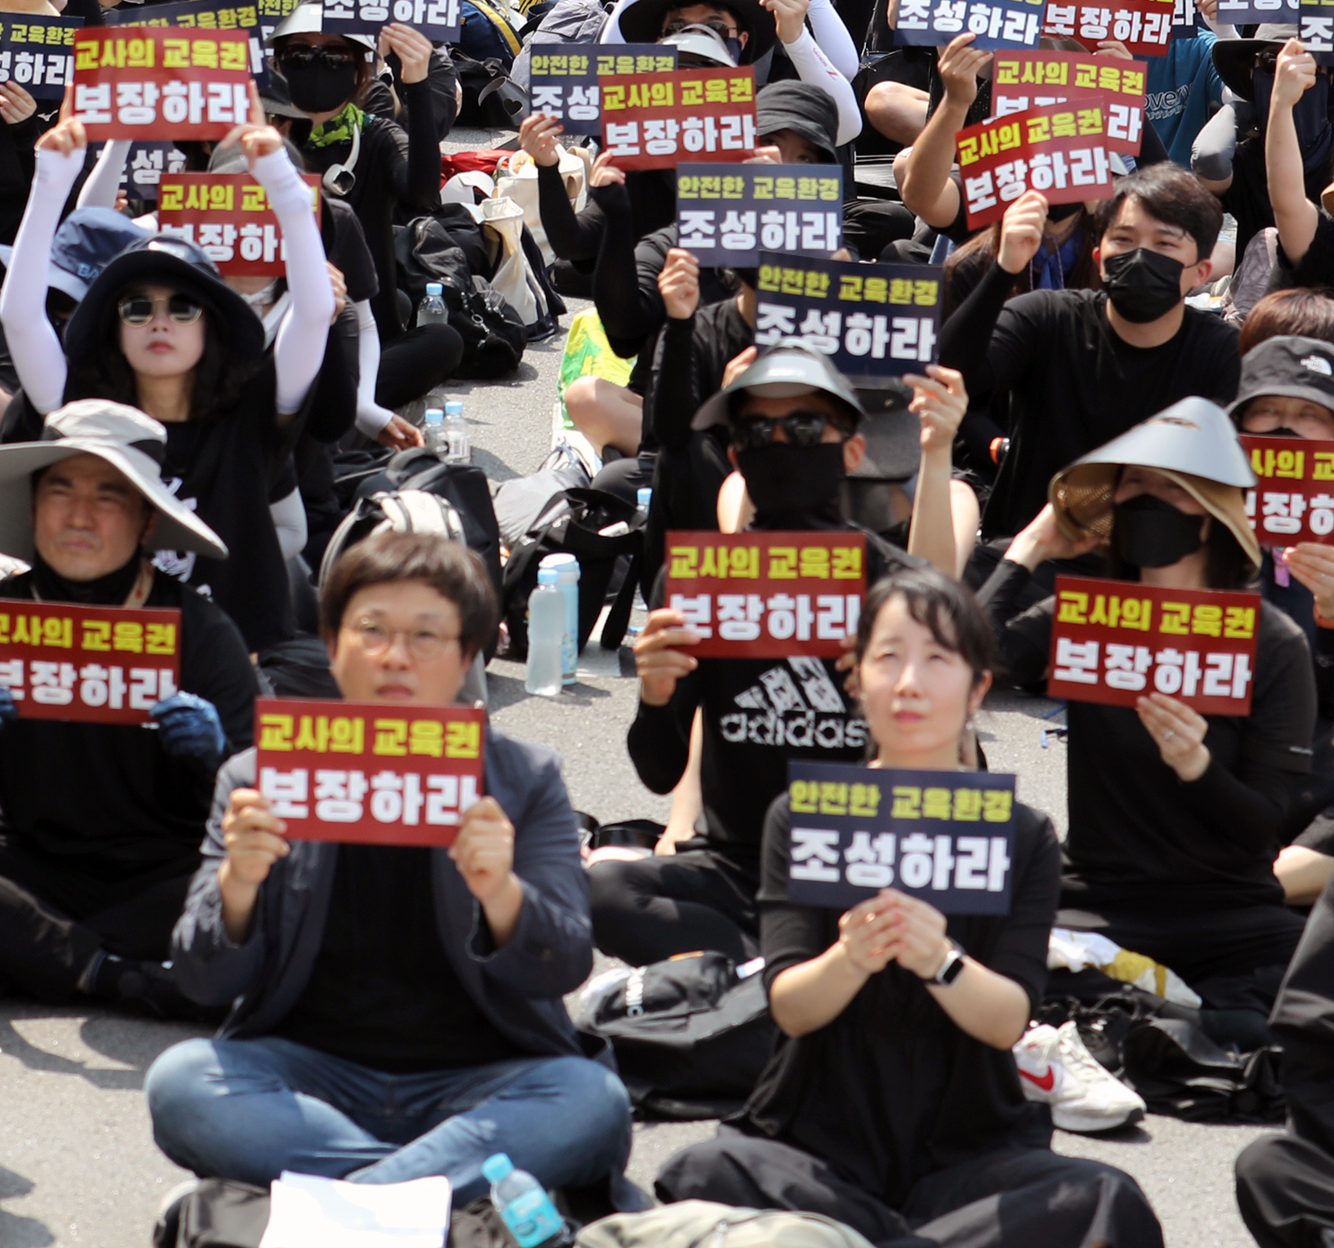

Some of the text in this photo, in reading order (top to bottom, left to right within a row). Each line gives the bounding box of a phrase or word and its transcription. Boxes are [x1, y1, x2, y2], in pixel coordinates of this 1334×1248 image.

[76, 39, 246, 70] 교사의 교육권
[74, 81, 252, 126] 보장하라
[678, 176, 838, 200] 안전한 교육환경
[679, 211, 840, 251] 조성하라
[1058, 591, 1255, 638] 교사의 교육권
[1054, 638, 1251, 698] 보장하라
[260, 715, 480, 758] 교사의 교육권
[720, 711, 868, 749] adidas
[260, 768, 483, 825] 보장하라
[790, 781, 1012, 822] 안전한 교육환경
[791, 828, 1010, 891] 조성하라
